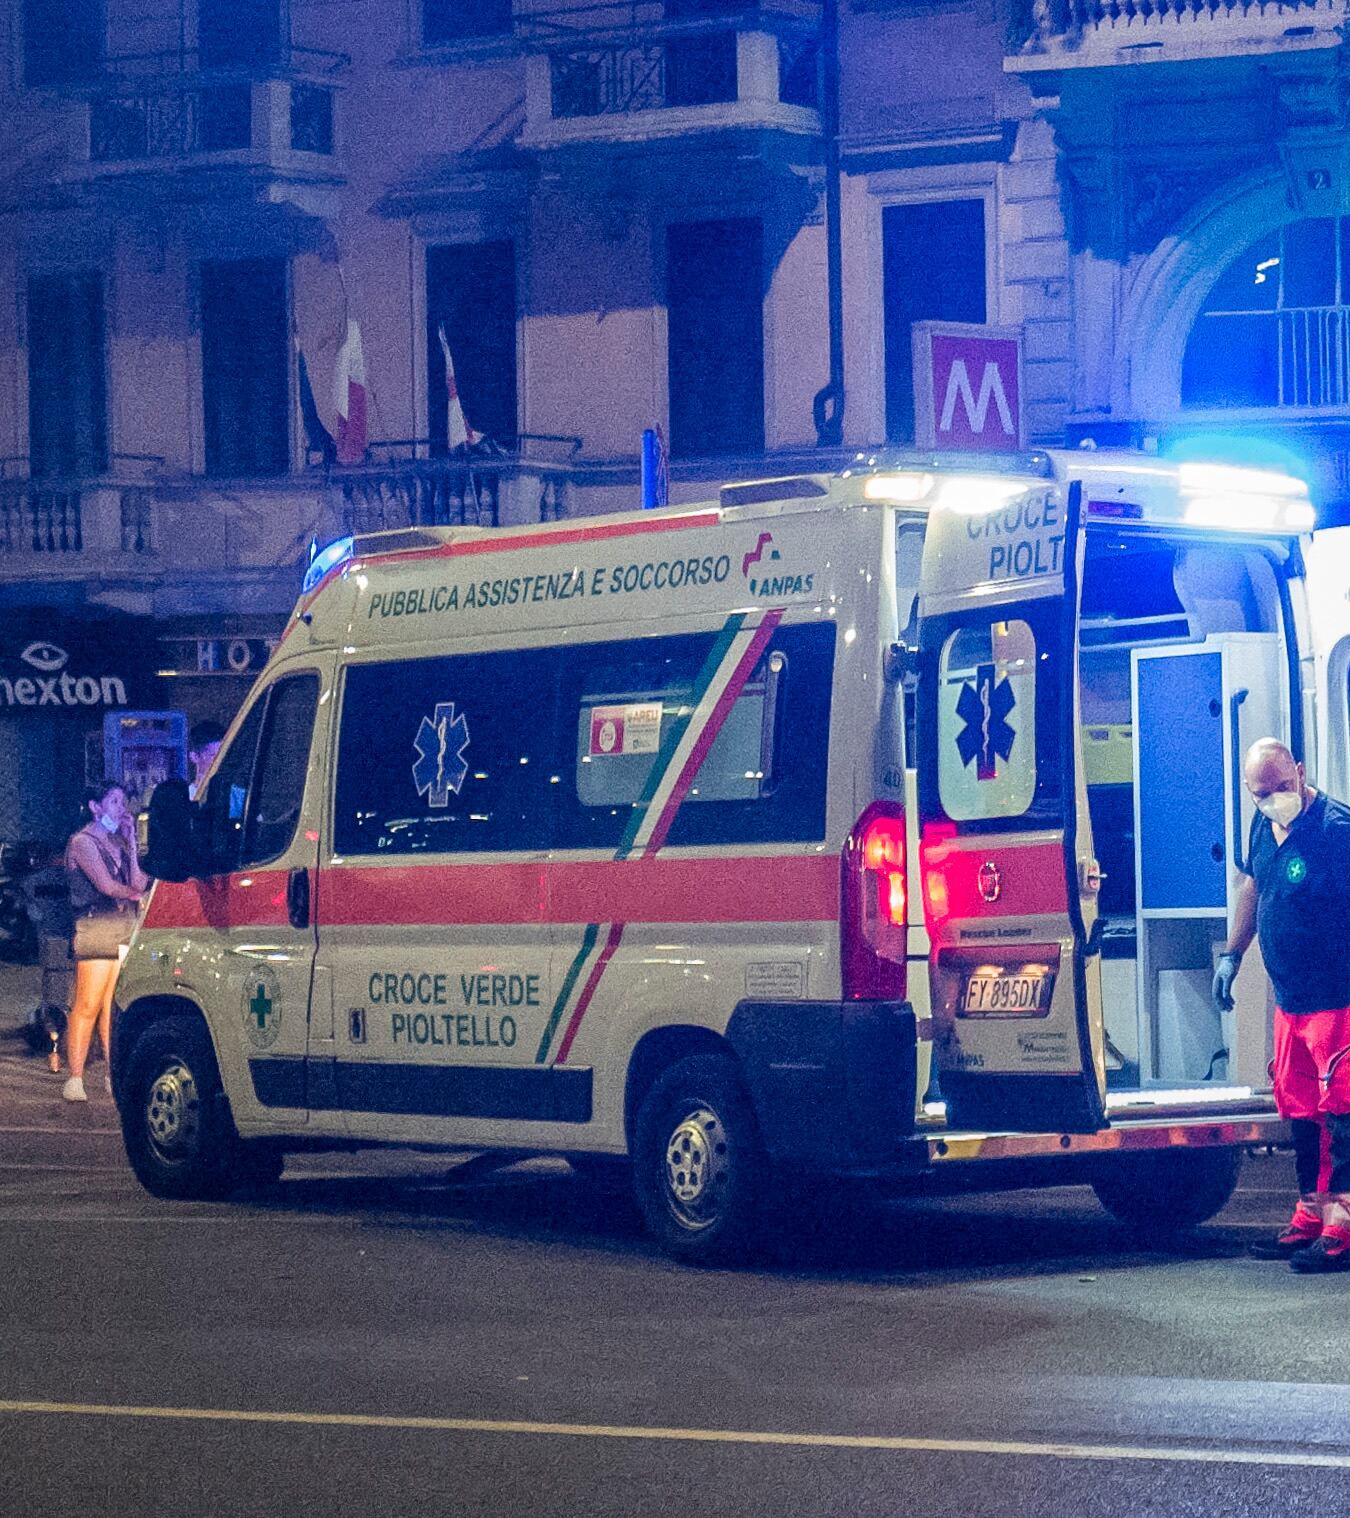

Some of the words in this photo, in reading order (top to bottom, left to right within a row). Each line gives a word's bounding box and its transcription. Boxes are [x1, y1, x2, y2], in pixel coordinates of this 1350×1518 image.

[940, 360, 1016, 434] M
[368, 585, 458, 618] PUBBLICA
[463, 570, 585, 608] ASSISTENZA
[591, 568, 606, 595] E
[610, 555, 730, 593] SOCCORSO
[758, 574, 814, 597] ANPAS
[368, 972, 447, 1004] CROCE
[461, 974, 541, 1006] VERDE
[968, 979, 987, 1008] FY
[990, 978, 1040, 1008] 895DX
[392, 1013, 517, 1047] PIOLTELLO
